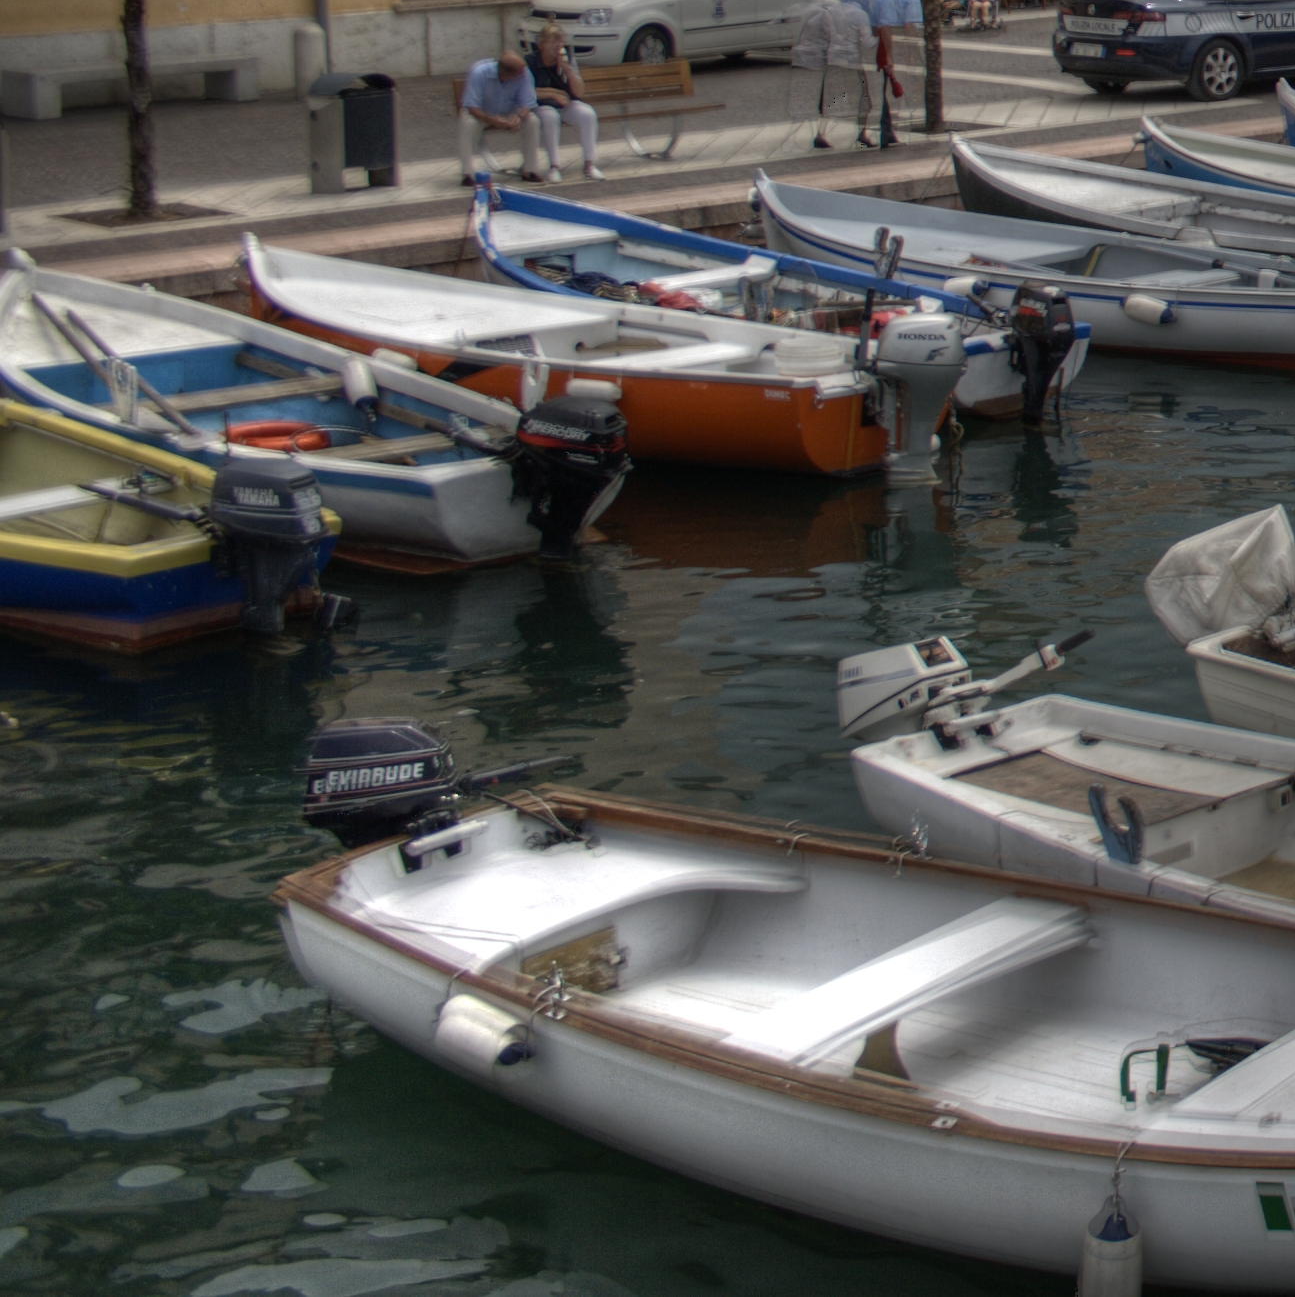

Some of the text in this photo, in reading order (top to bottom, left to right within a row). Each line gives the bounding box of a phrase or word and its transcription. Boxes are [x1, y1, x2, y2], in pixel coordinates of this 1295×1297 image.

[897, 332, 949, 342] HONDA
[233, 486, 280, 507] YAMAHA
[313, 762, 425, 795] EVINRUDE
